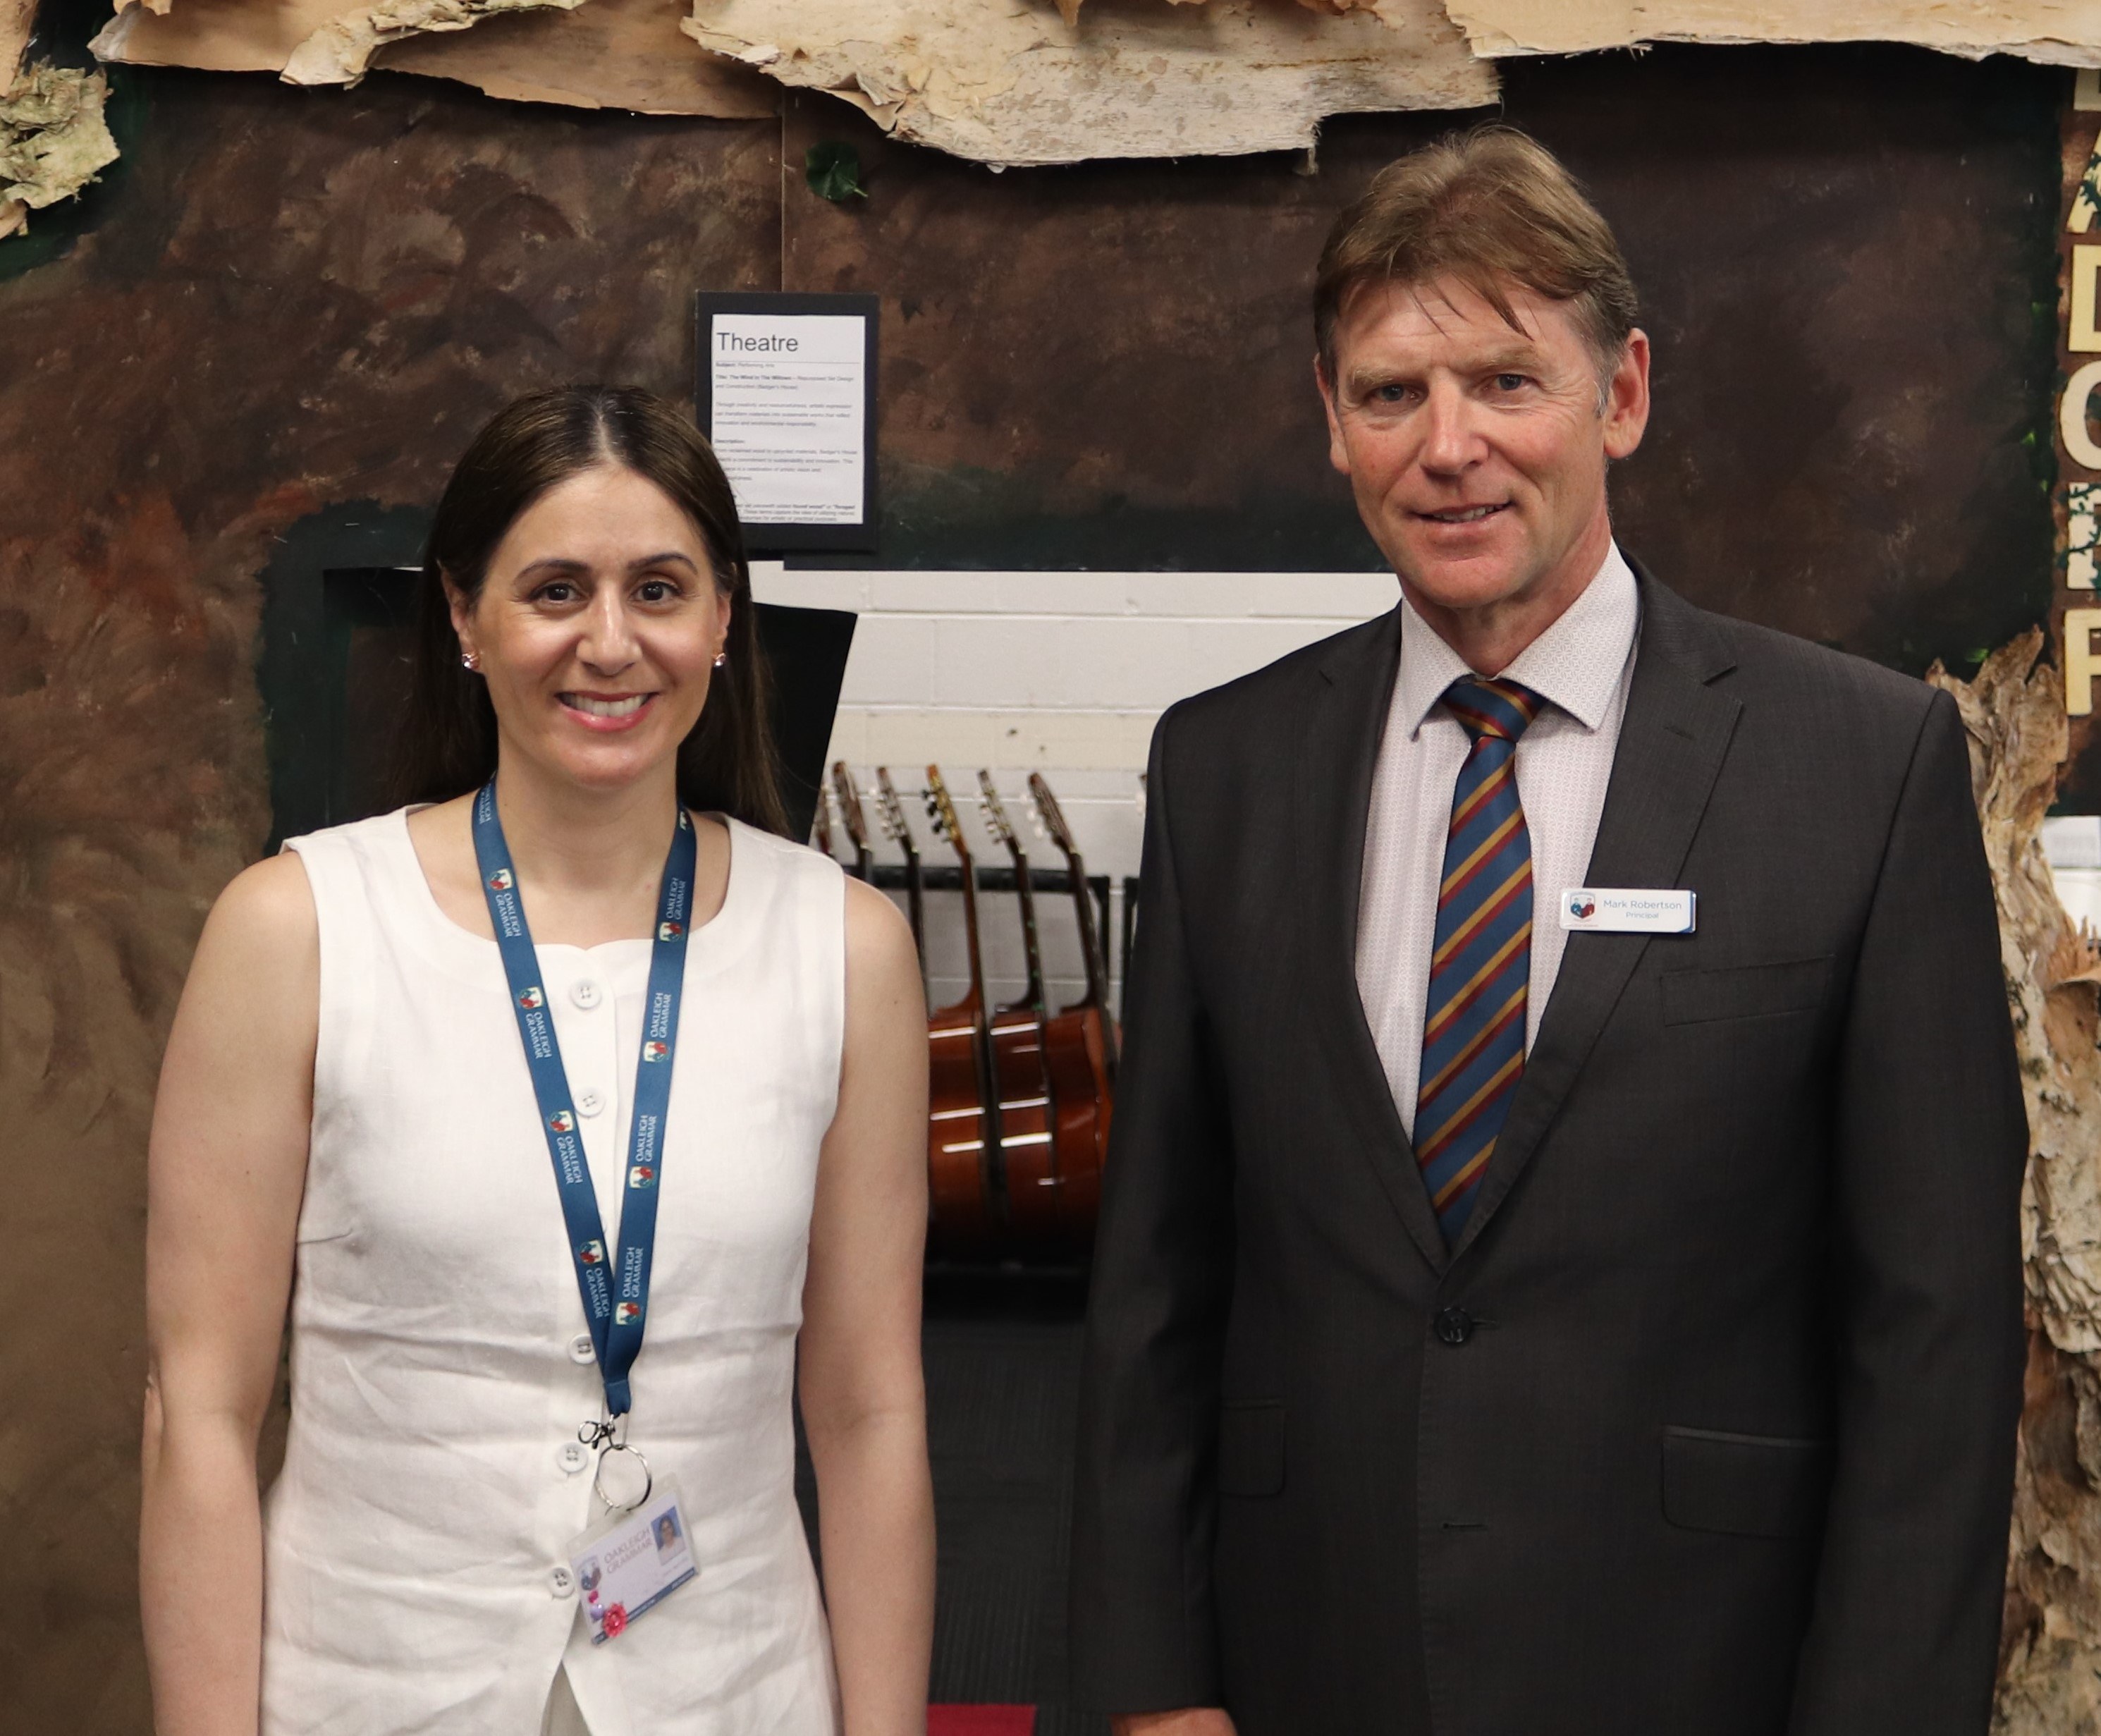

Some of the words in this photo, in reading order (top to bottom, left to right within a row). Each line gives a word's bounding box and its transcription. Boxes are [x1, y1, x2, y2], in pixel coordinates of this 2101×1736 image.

[716, 332, 799, 352] Theatre
[495, 894, 513, 939] GRAMMAR
[503, 893, 522, 937] OAKLEIGH
[1603, 899, 1627, 908] Mark
[1630, 901, 1682, 910] Robertson
[1626, 911, 1660, 919] Principal
[525, 1013, 543, 1060] GRAMMAR
[534, 1011, 553, 1059] OAKLEIGH
[650, 992, 664, 1038] OAKLEIGH
[659, 994, 672, 1039] GRAMMAR
[556, 1136, 575, 1185] GRAMMAR
[565, 1135, 584, 1185] OAKLEIGH
[635, 1114, 649, 1162] OAKLEIGH
[644, 1115, 657, 1163] GRAMMAR
[585, 1269, 603, 1320] GRAMMAR
[594, 1266, 611, 1318] OAKLEIGH
[622, 1246, 636, 1298] OAKLEIGH
[631, 1247, 644, 1299] GRAMMAR
[604, 1526, 652, 1565] OAKLEIGH
